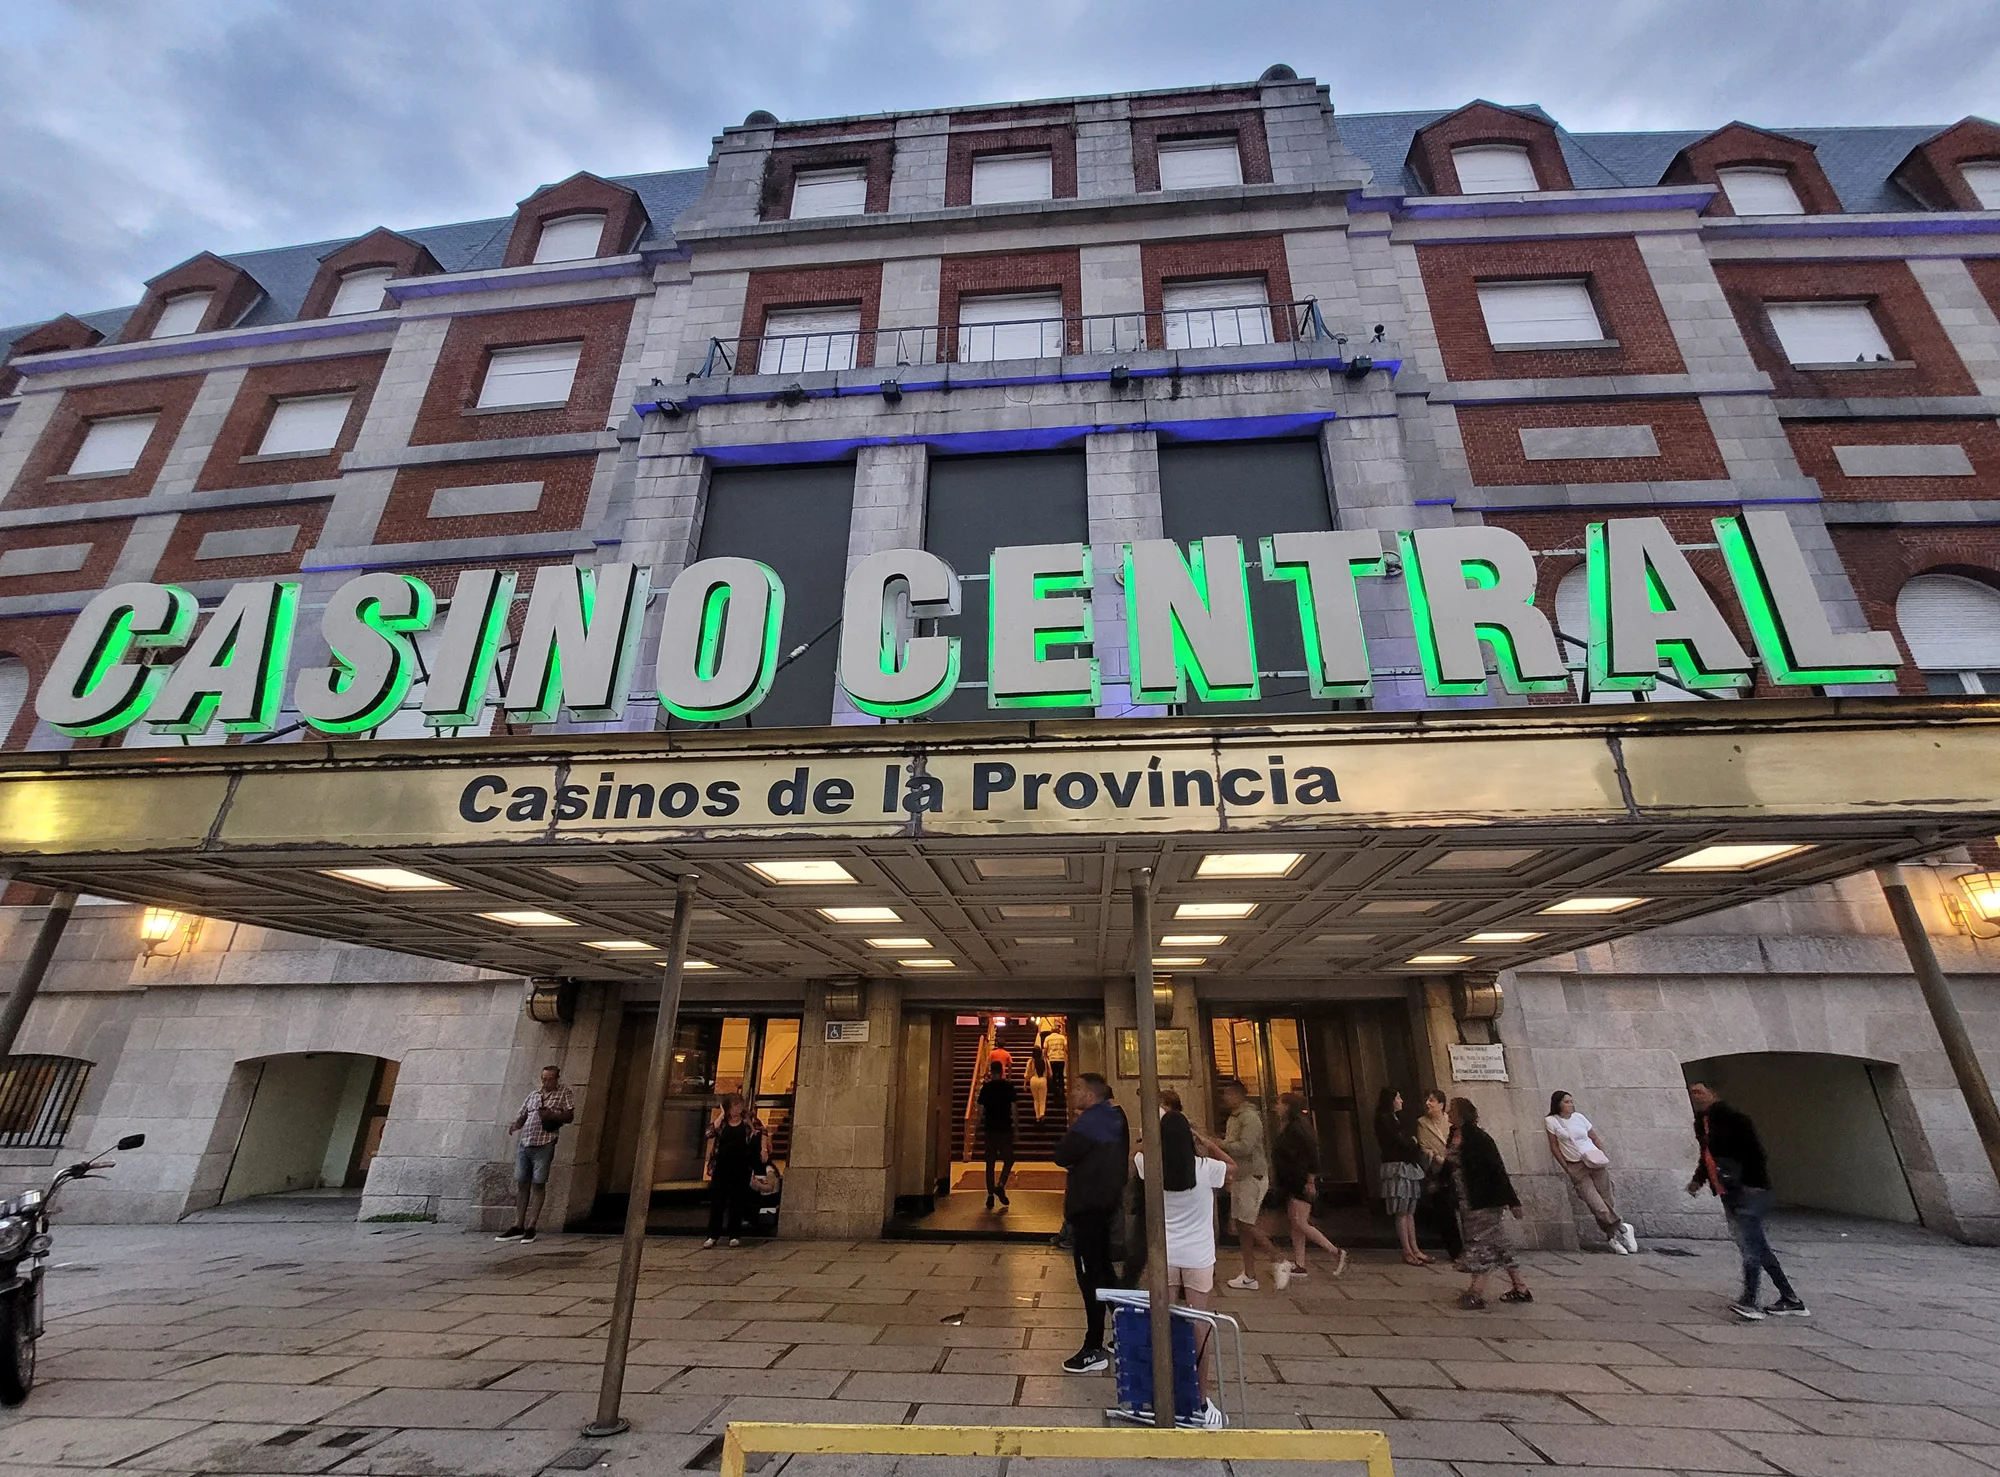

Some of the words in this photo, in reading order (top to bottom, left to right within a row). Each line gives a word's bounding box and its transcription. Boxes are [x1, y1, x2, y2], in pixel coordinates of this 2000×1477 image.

[36, 556, 786, 739] CASINO
[838, 510, 1904, 718] CENTRAL
[459, 770, 739, 824] Casinos
[766, 766, 855, 814] de
[883, 763, 944, 813] la
[1083, 1354, 1097, 1364] FILA
